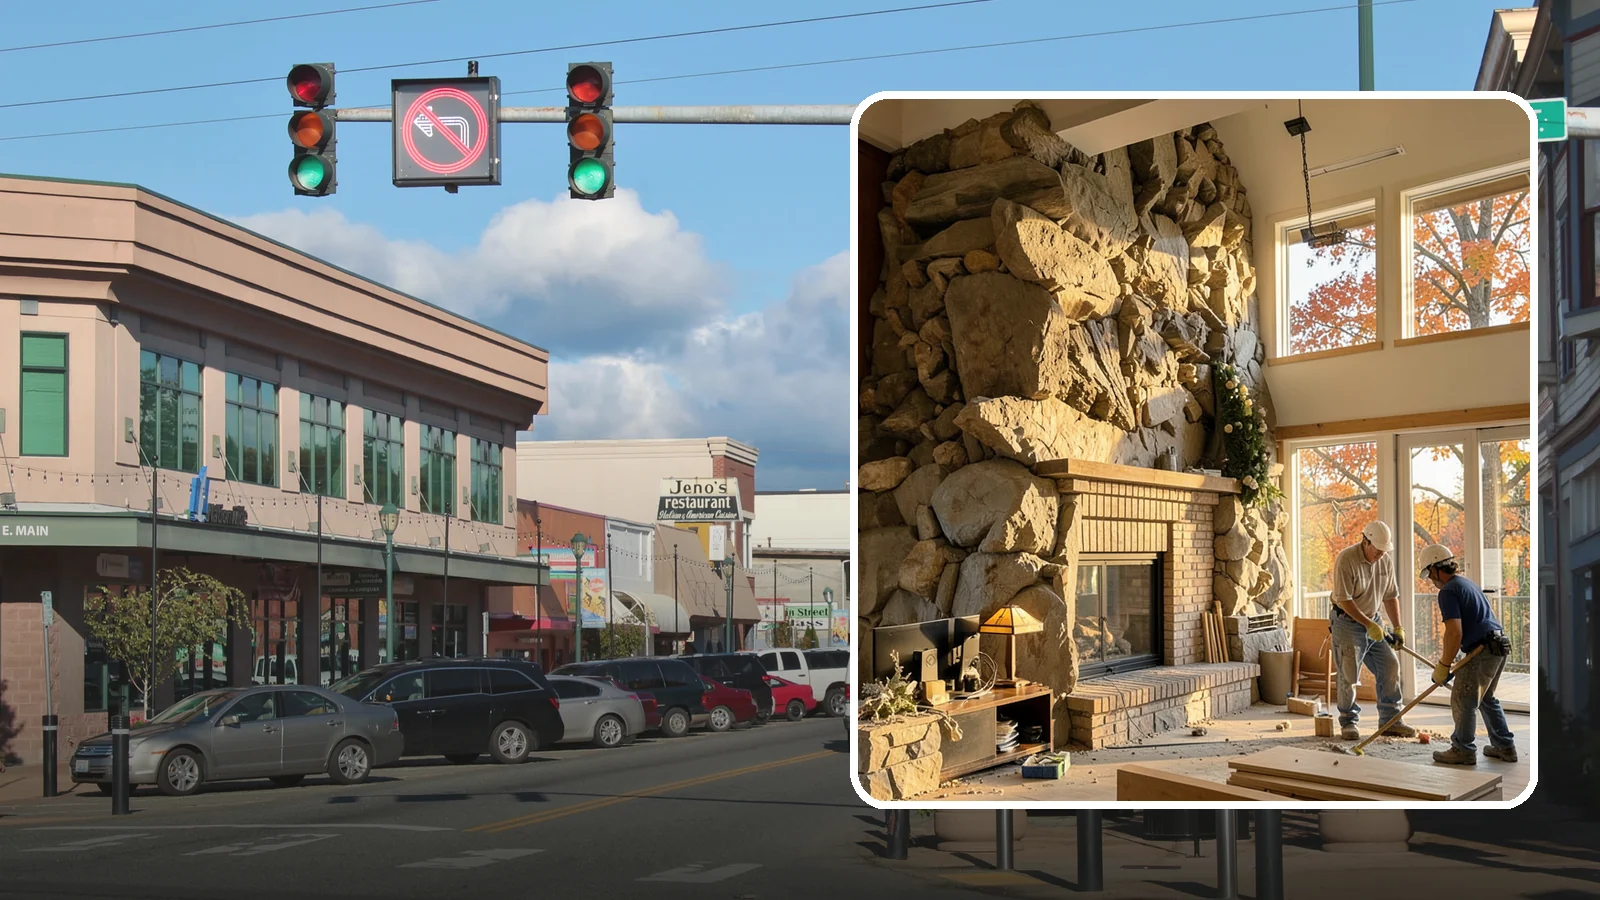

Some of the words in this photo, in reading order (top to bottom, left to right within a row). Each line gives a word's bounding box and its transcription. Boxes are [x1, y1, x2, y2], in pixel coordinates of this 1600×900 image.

[670, 480, 728, 495] Jeno's
[665, 496, 731, 509] restaurant
[658, 510, 681, 520] Italian
[686, 509, 714, 520] American
[715, 509, 738, 519] Cuisine
[2, 525, 13, 536] E.
[15, 525, 49, 536] MAIN
[797, 607, 829, 617] Street
